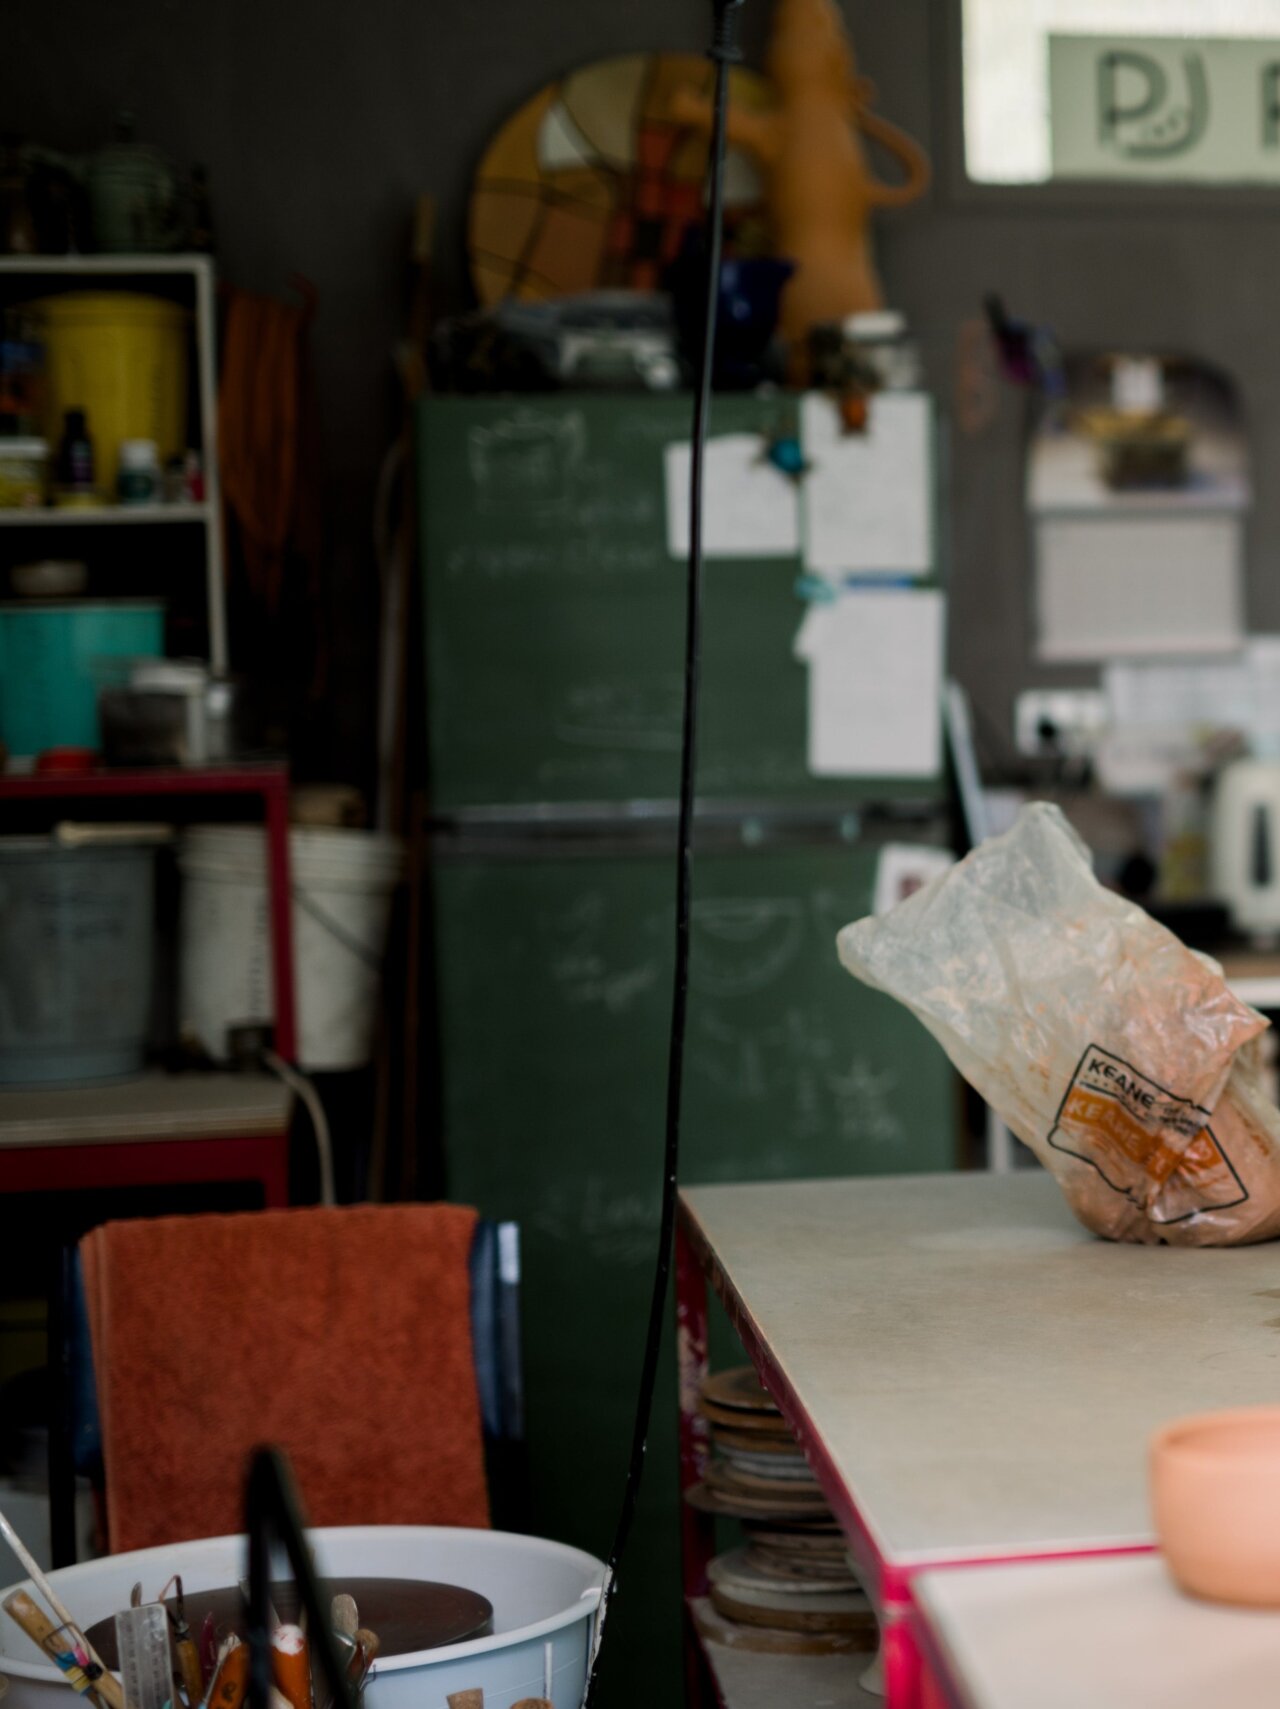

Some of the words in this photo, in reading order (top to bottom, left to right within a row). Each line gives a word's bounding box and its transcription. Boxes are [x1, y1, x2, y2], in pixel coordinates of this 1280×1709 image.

[1097, 50, 1210, 160] PJ
[1088, 1058, 1155, 1108] KEANE
[1065, 1098, 1142, 1155] KEANE
